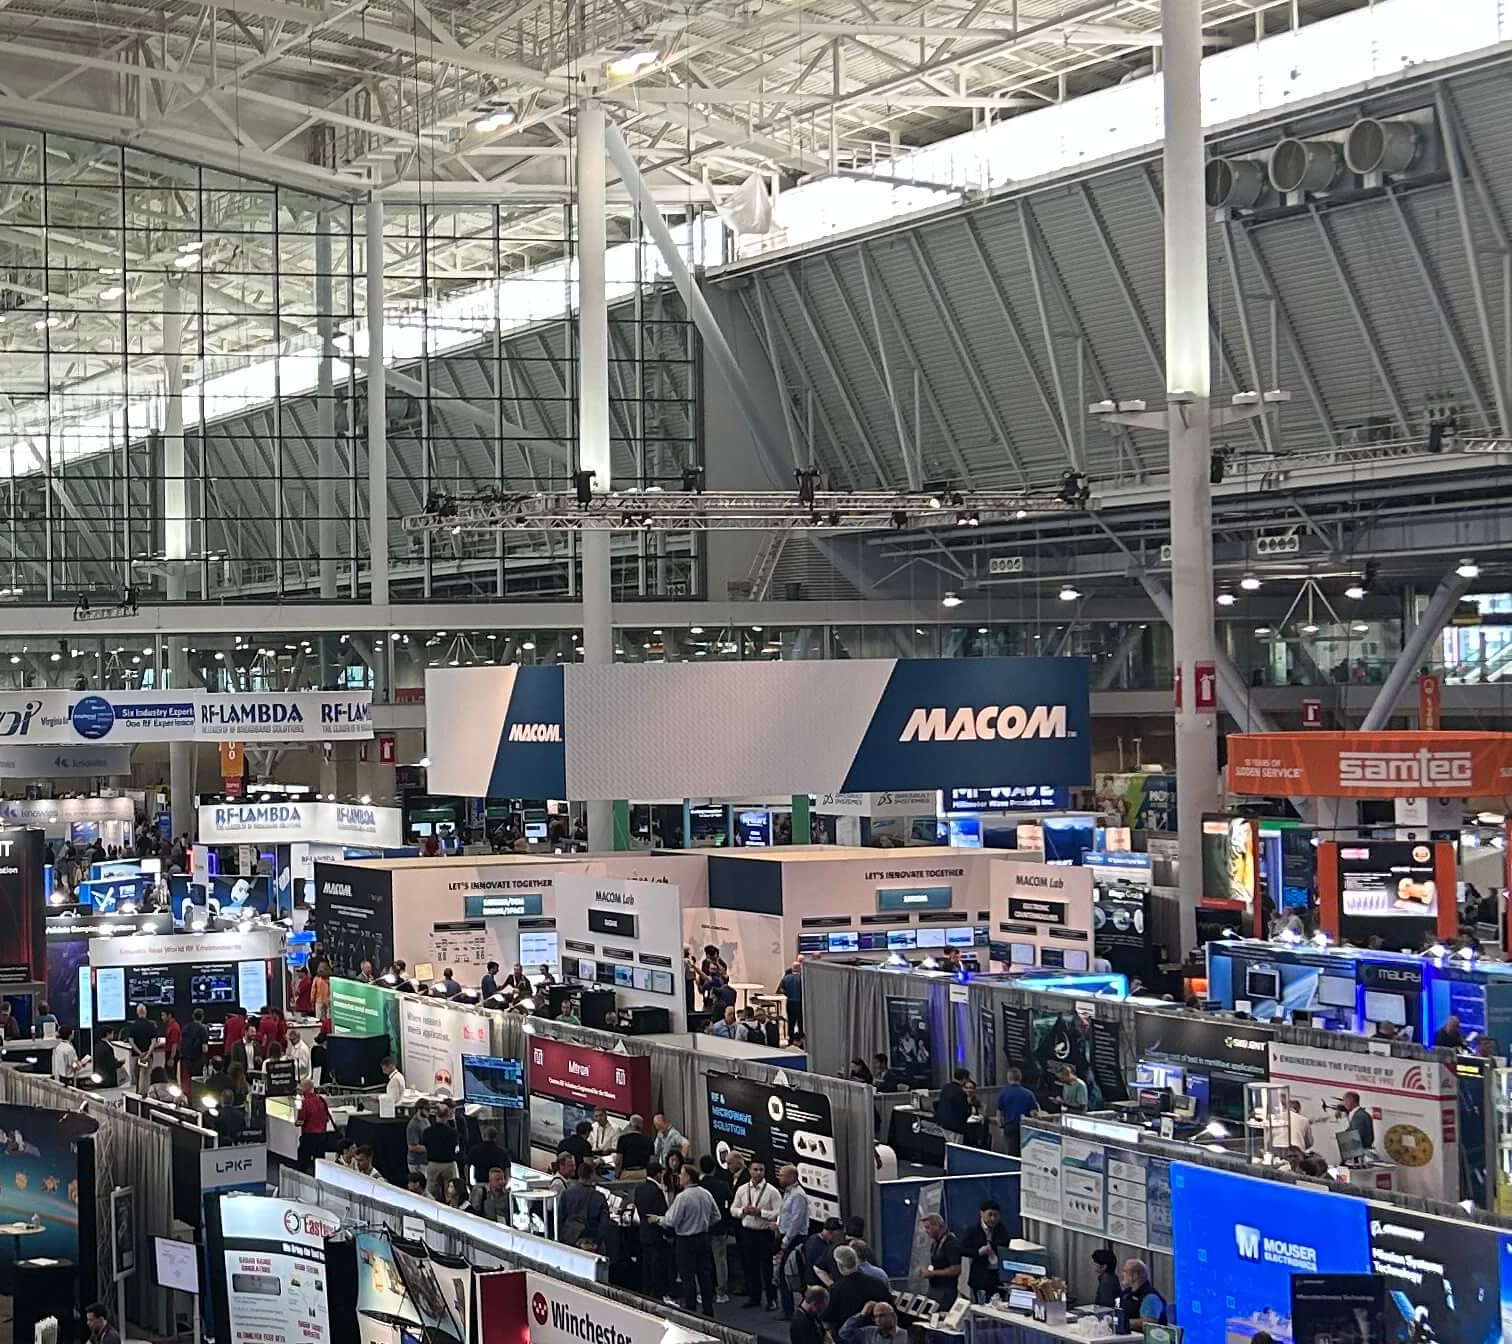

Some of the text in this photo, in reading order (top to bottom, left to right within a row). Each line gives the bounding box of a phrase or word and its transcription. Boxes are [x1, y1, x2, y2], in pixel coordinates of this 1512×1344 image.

[122, 708, 135, 718] Six
[136, 708, 167, 719] Industry
[202, 703, 304, 723] RF-LAMBDA
[125, 719, 141, 728] One
[143, 719, 152, 728] RF
[509, 723, 561, 742] MACOM
[899, 706, 1067, 742] MACOM
[1339, 748, 1471, 788] samtec
[216, 806, 301, 824] RF-LAMBDA
[926, 868, 964, 878] TOGETHER
[1016, 874, 1064, 889] MACOM Lab
[512, 879, 553, 889] TOGETHER
[1279, 1054, 1325, 1069] ENGINEERING
[1326, 1060, 1341, 1070] THE
[1342, 1062, 1372, 1074] FUTURE
[216, 1158, 253, 1174] LPKF
[1263, 1238, 1317, 1262] MOUSER
[1264, 1253, 1317, 1272] ELECTRONICS
